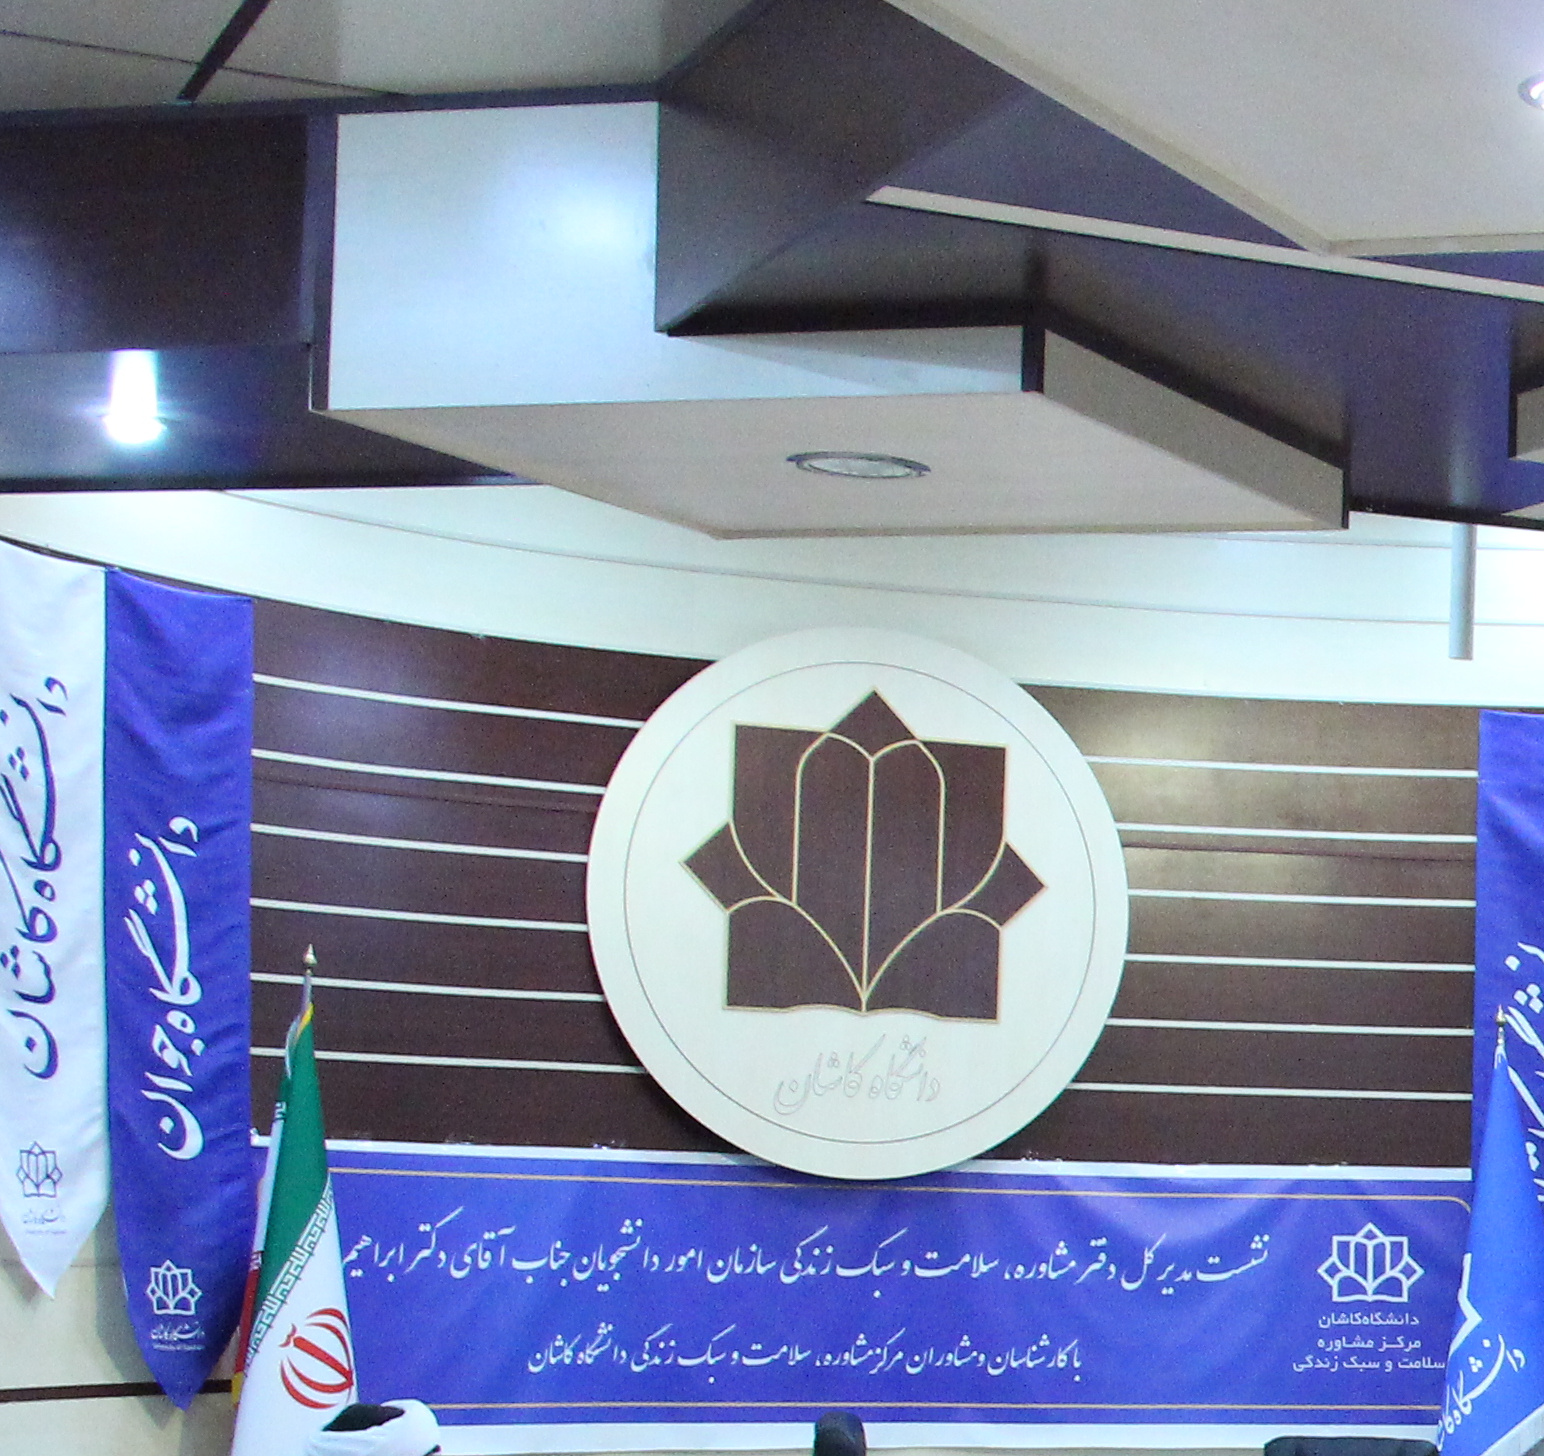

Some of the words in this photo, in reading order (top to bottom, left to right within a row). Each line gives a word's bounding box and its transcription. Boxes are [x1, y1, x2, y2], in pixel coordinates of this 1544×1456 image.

[124, 815, 203, 1034] دانشگاه
[773, 1033, 887, 1115] کاشان
[869, 1033, 941, 1102] دانشگاه
[141, 1024, 206, 1162] جوان
[404, 1205, 464, 1275] دکتر
[450, 1225, 517, 1280] آقای
[572, 1217, 660, 1292] دانشجویان
[664, 1247, 704, 1272] امور
[780, 1225, 834, 1285] زندگی
[836, 1227, 908, 1298] سبک
[1073, 1237, 1117, 1285] دفتر
[1197, 1233, 1271, 1282] نشست
[511, 1239, 572, 1288] جناب
[706, 1243, 777, 1284] سازمان
[901, 1259, 912, 1276] و
[915, 1250, 999, 1278] سلامت
[527, 1333, 583, 1374] کاشان
[576, 1322, 628, 1365] دانشگاه
[630, 1323, 677, 1373] زندگی
[677, 1323, 737, 1385] سبک
[730, 1350, 740, 1364] و
[742, 1343, 812, 1367] سلامت
[868, 1327, 907, 1375] مرکز
[986, 1333, 1078, 1376] کارشناسان
[1292, 1355, 1339, 1373] زندگی
[1317, 1335, 1375, 1352] مشاوره
[1342, 1356, 1380, 1373] سبک
[1378, 1336, 1422, 1352] مرکز
[1384, 1360, 1393, 1372] و
[1397, 1357, 1446, 1370] سلامت
